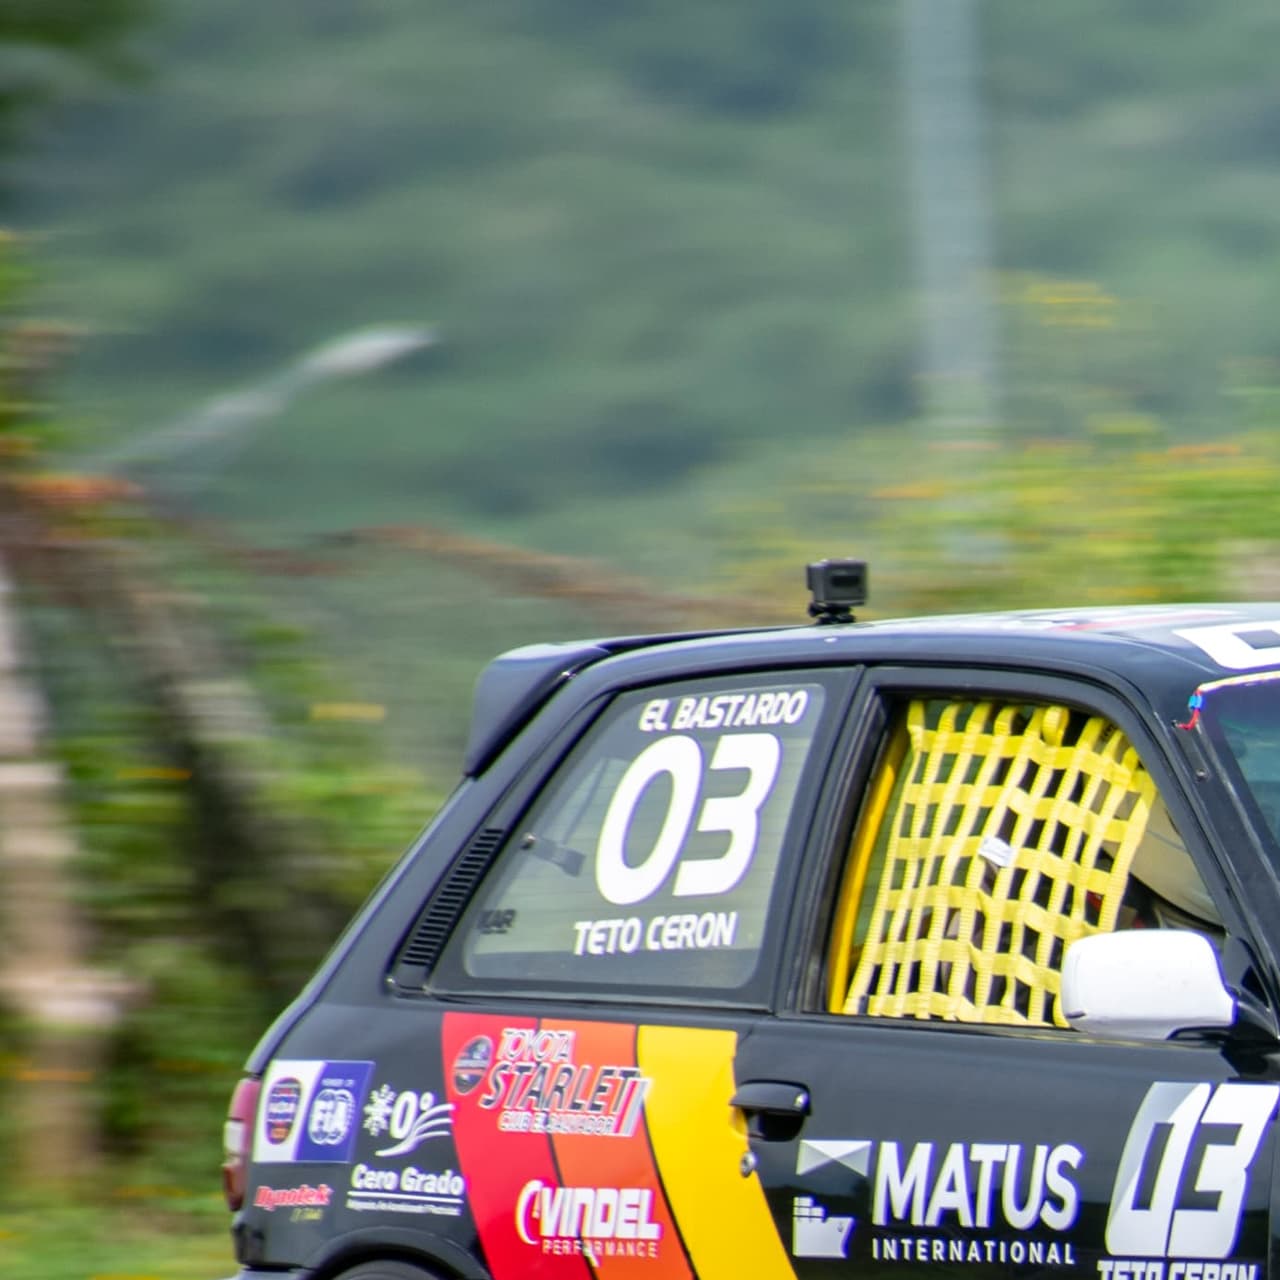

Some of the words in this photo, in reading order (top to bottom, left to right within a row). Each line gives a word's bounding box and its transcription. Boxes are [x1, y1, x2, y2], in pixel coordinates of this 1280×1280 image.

[639, 698, 672, 732] EL
[672, 690, 808, 729] BASTARDO
[596, 732, 782, 905] 03
[573, 917, 641, 956] TETO
[645, 911, 737, 951] CERON
[497, 1028, 575, 1062] TOYOTA
[479, 1062, 645, 1115] STARLET
[352, 1163, 398, 1190] Cero
[400, 1166, 465, 1196] Grado
[873, 1141, 1083, 1231] MATUS
[541, 1239, 658, 1258] PERFORMANCE
[872, 1238, 1075, 1265] INTERNATIONAL
